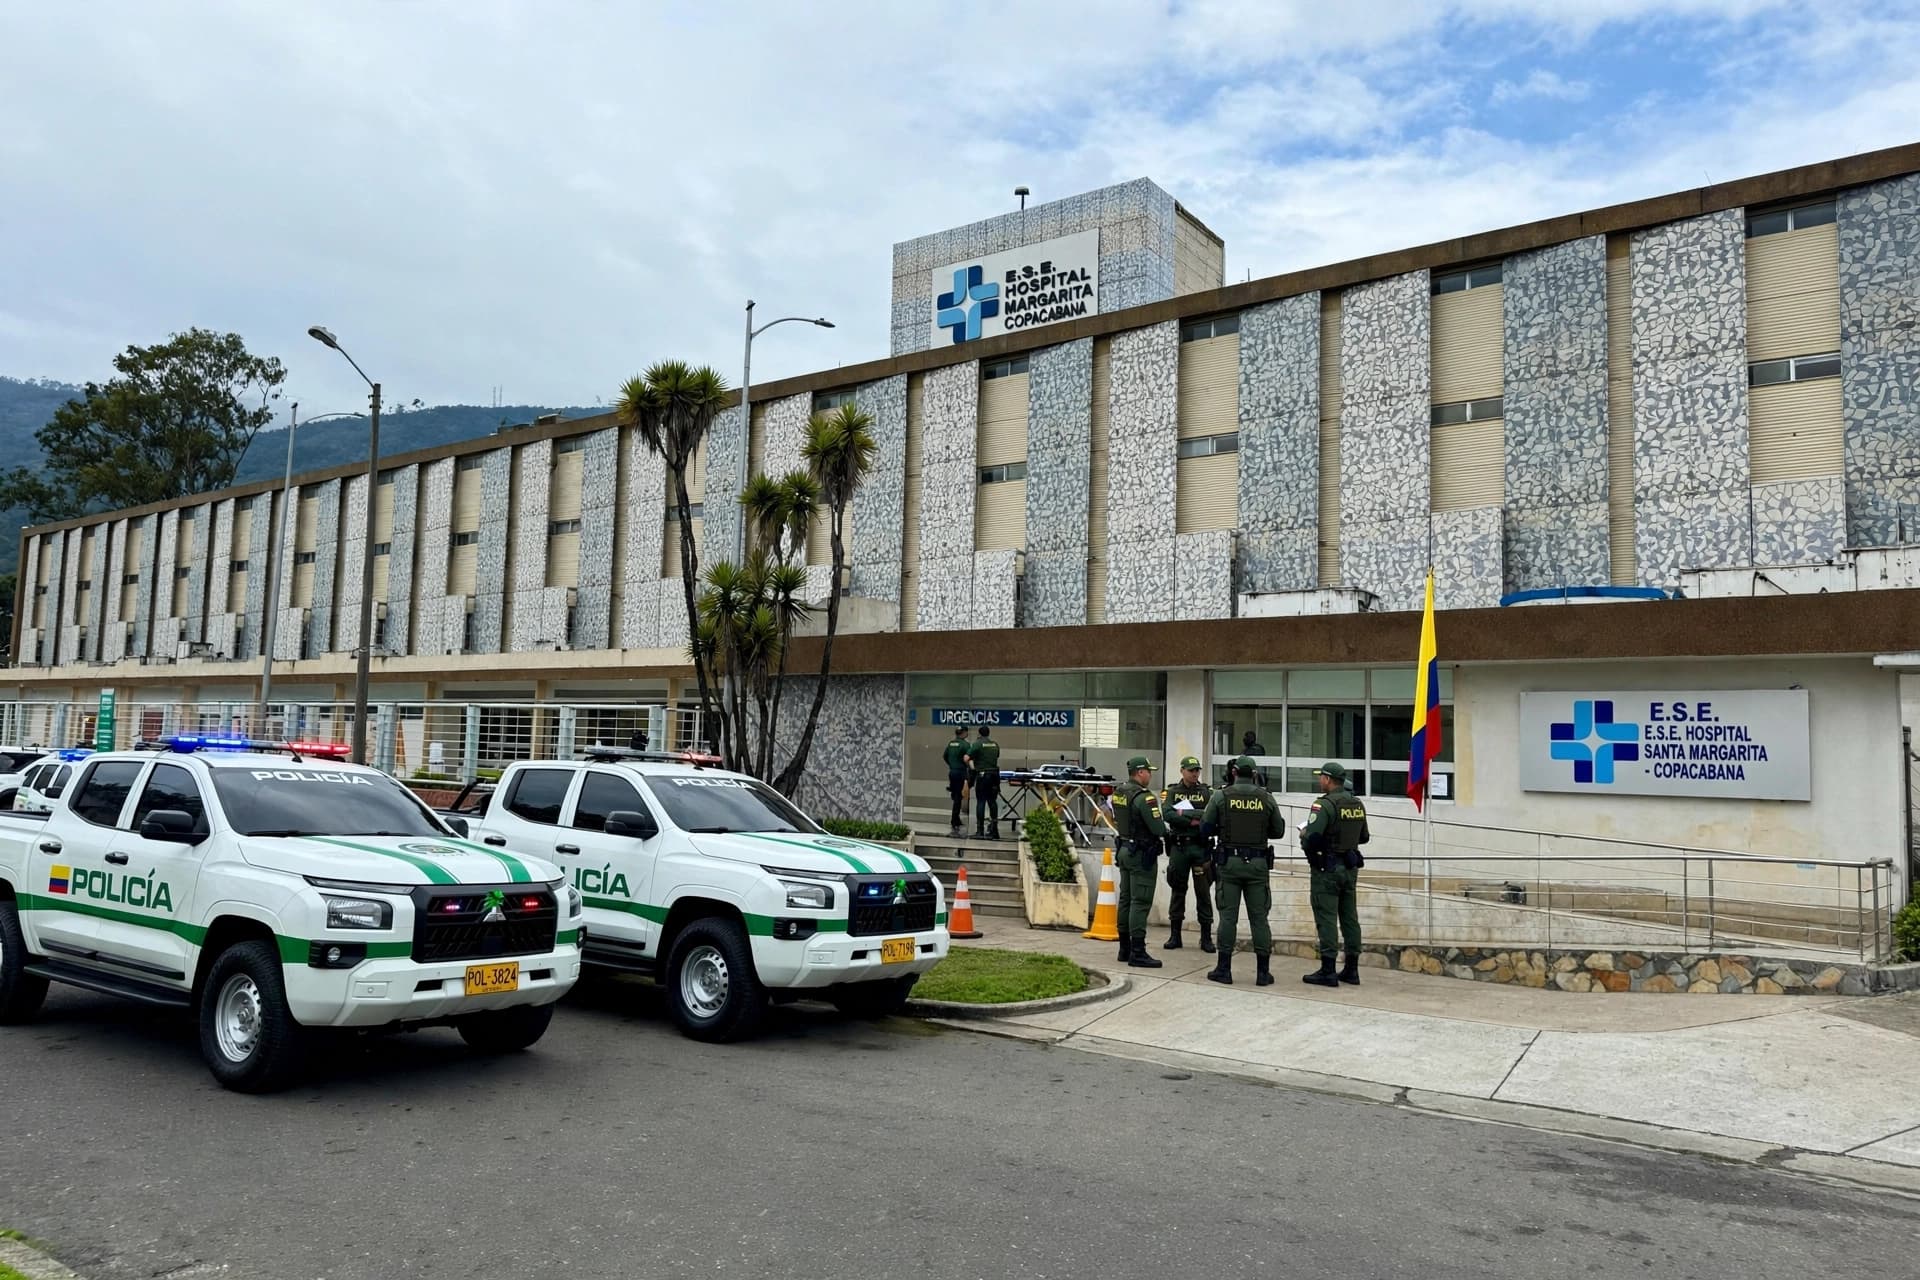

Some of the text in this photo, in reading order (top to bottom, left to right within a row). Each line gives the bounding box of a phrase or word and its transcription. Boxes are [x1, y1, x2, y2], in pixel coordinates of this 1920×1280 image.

[1005, 261, 1056, 283] E.S.E.
[1005, 267, 1091, 299] HOSPITAL
[1005, 283, 1094, 315] MARGARITA
[1004, 301, 1087, 330] COPACABANA
[940, 710, 1068, 726] URGENCIAS 24 HORAS
[1650, 702, 1719, 722] E.S.E.
[1645, 725, 1752, 742] E.S.E. HOSPITAL
[1644, 744, 1768, 762] SANTA MARGARITA
[250, 770, 374, 786] POLICÍA
[1654, 763, 1745, 781] COPACABANA
[1230, 798, 1263, 811] POLICÍA
[71, 867, 173, 913] POLICÍA
[560, 862, 631, 898] ICÍA
[467, 967, 516, 987] POL-3824
